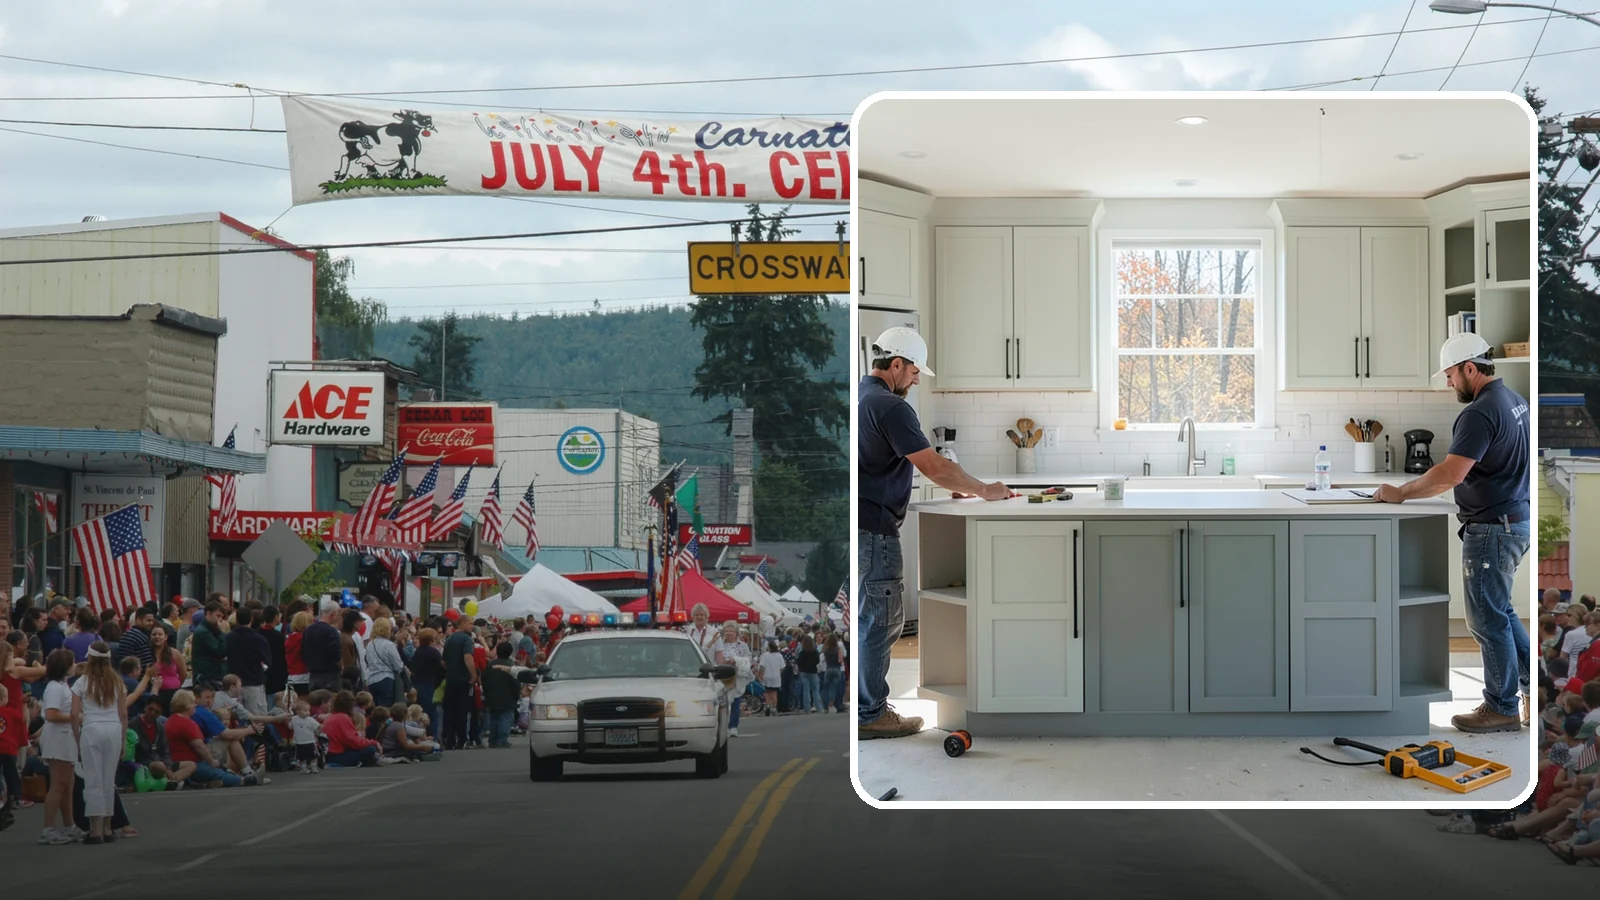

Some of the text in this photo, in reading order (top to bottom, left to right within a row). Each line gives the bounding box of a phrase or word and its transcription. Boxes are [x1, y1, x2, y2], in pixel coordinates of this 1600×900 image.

[481, 140, 605, 192] JULY
[632, 148, 746, 198] 4th.
[697, 254, 850, 280] CROSSWA
[283, 380, 374, 420] ACE
[406, 409, 452, 422] CEDAR
[283, 420, 371, 436] Hardware
[416, 428, 477, 446] Coca-Cola
[353, 467, 384, 480] Simpl
[83, 484, 155, 495] St. Vincent de Paul
[212, 515, 331, 536] HARDARE
[688, 526, 741, 535] CRNATION
[699, 535, 730, 543] GLASS
